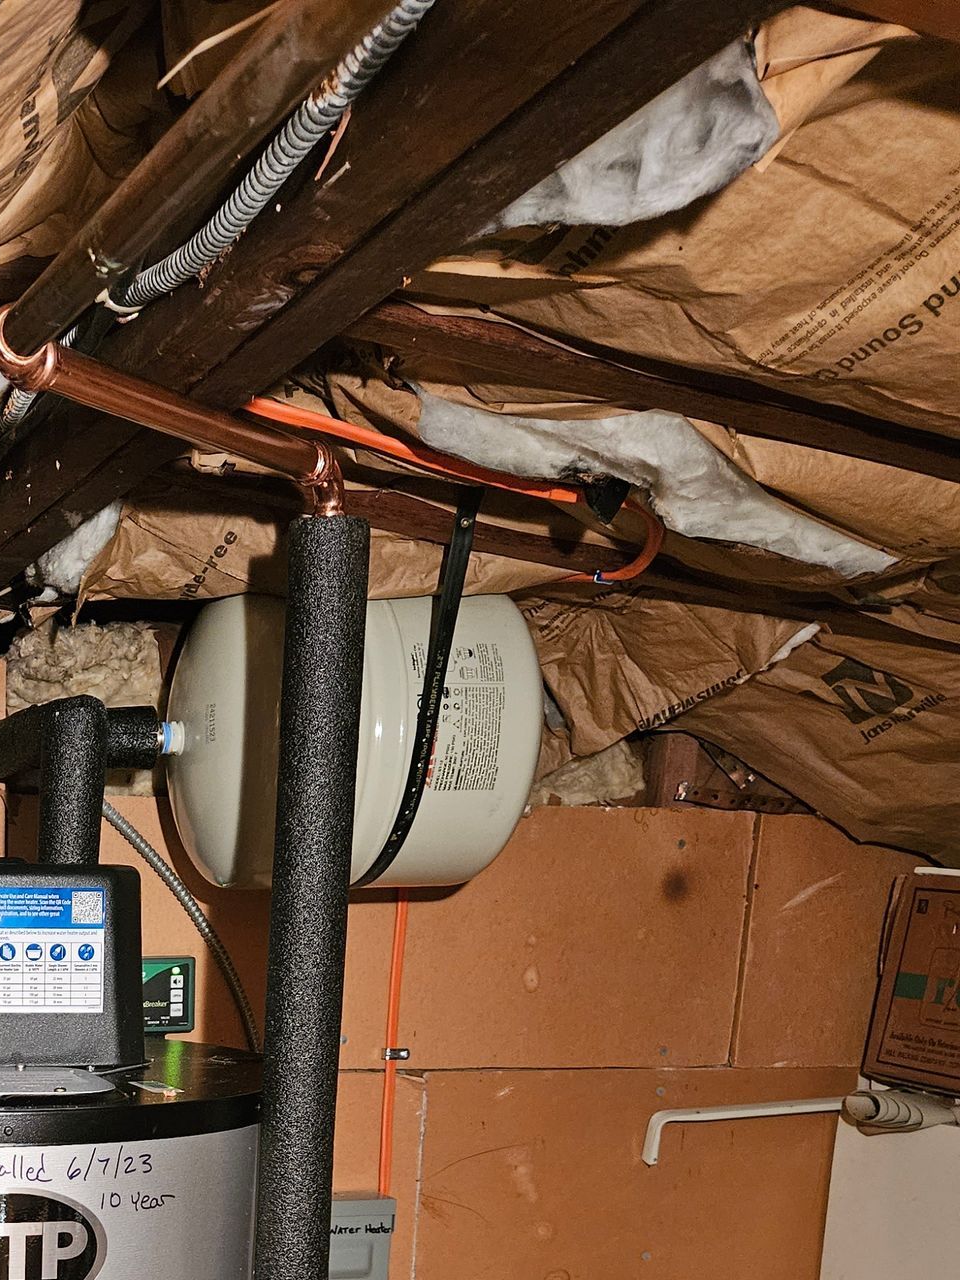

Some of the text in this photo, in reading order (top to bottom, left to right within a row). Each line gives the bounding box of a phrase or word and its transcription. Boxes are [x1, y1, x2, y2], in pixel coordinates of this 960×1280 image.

[876, 262, 894, 279] and
[899, 260, 917, 276] not
[840, 277, 877, 311] installed
[876, 272, 901, 295] leave
[789, 318, 809, 336] heat
[836, 268, 960, 373] nd Sound
[769, 330, 791, 350] away
[786, 316, 829, 355] compliance
[67, 1145, 153, 1181] 6/7/23
[100, 1192, 121, 1209] 10
